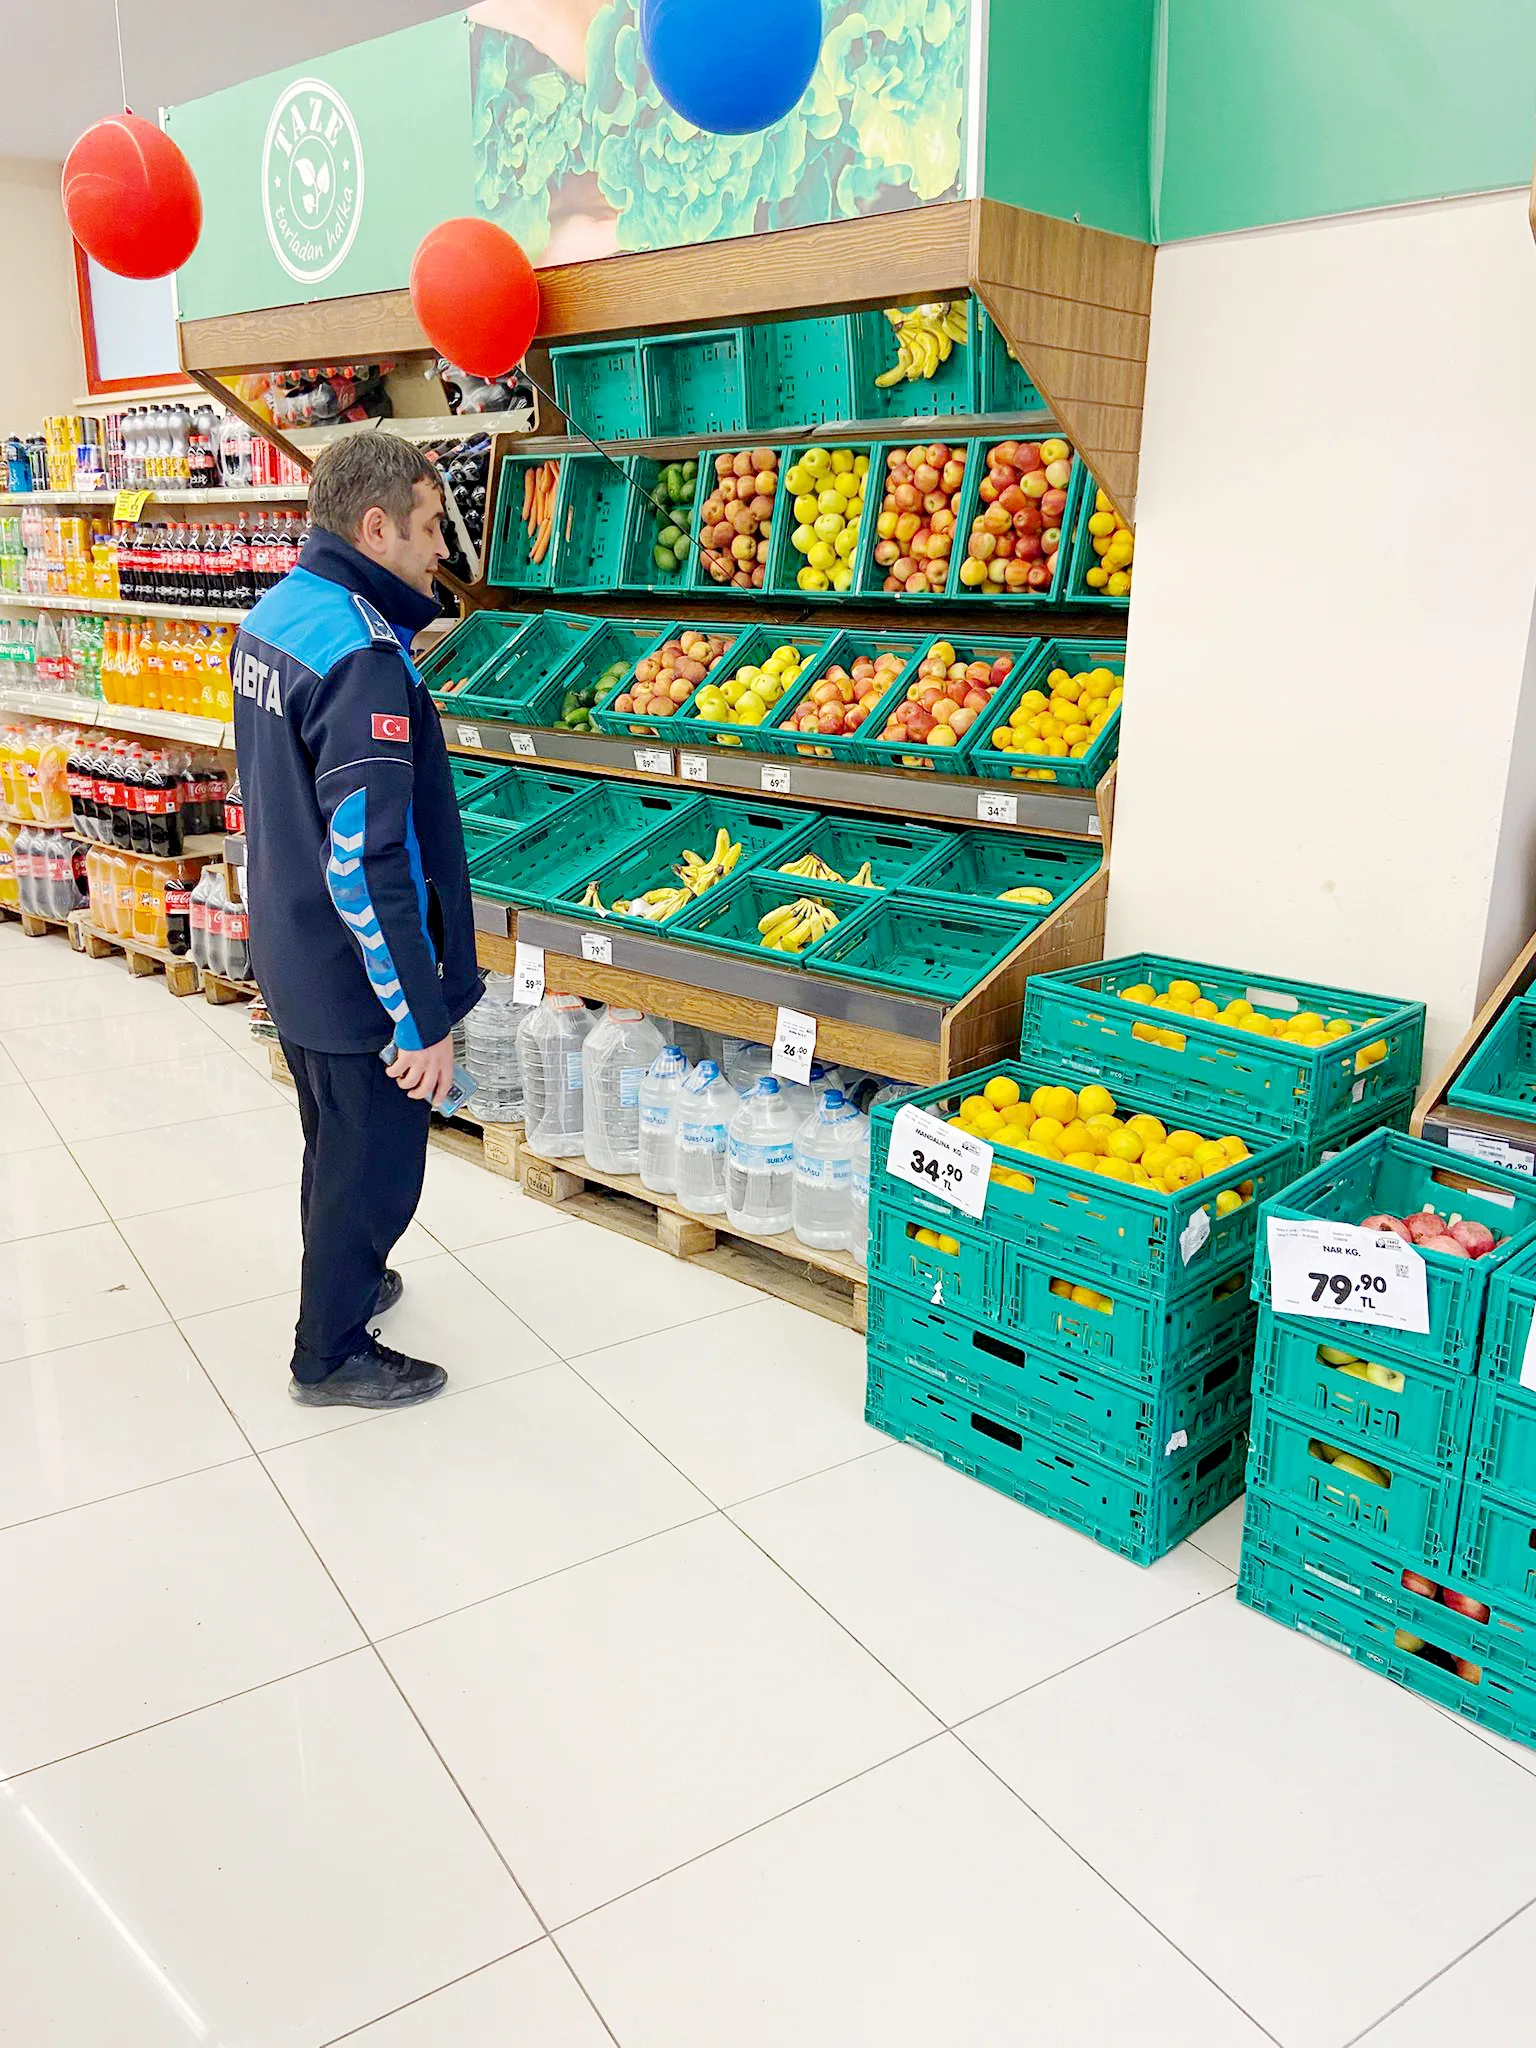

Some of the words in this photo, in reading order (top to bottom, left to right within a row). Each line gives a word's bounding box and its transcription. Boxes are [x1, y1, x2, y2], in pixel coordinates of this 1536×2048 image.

[274, 97, 344, 158] TAZE
[275, 204, 324, 262] tarladan
[325, 186, 354, 251] halka
[943, 1179, 953, 1192] TL
[1323, 1245, 1343, 1254] NAR
[1345, 1248, 1361, 1258] KG.
[1360, 1296, 1376, 1309] TL
